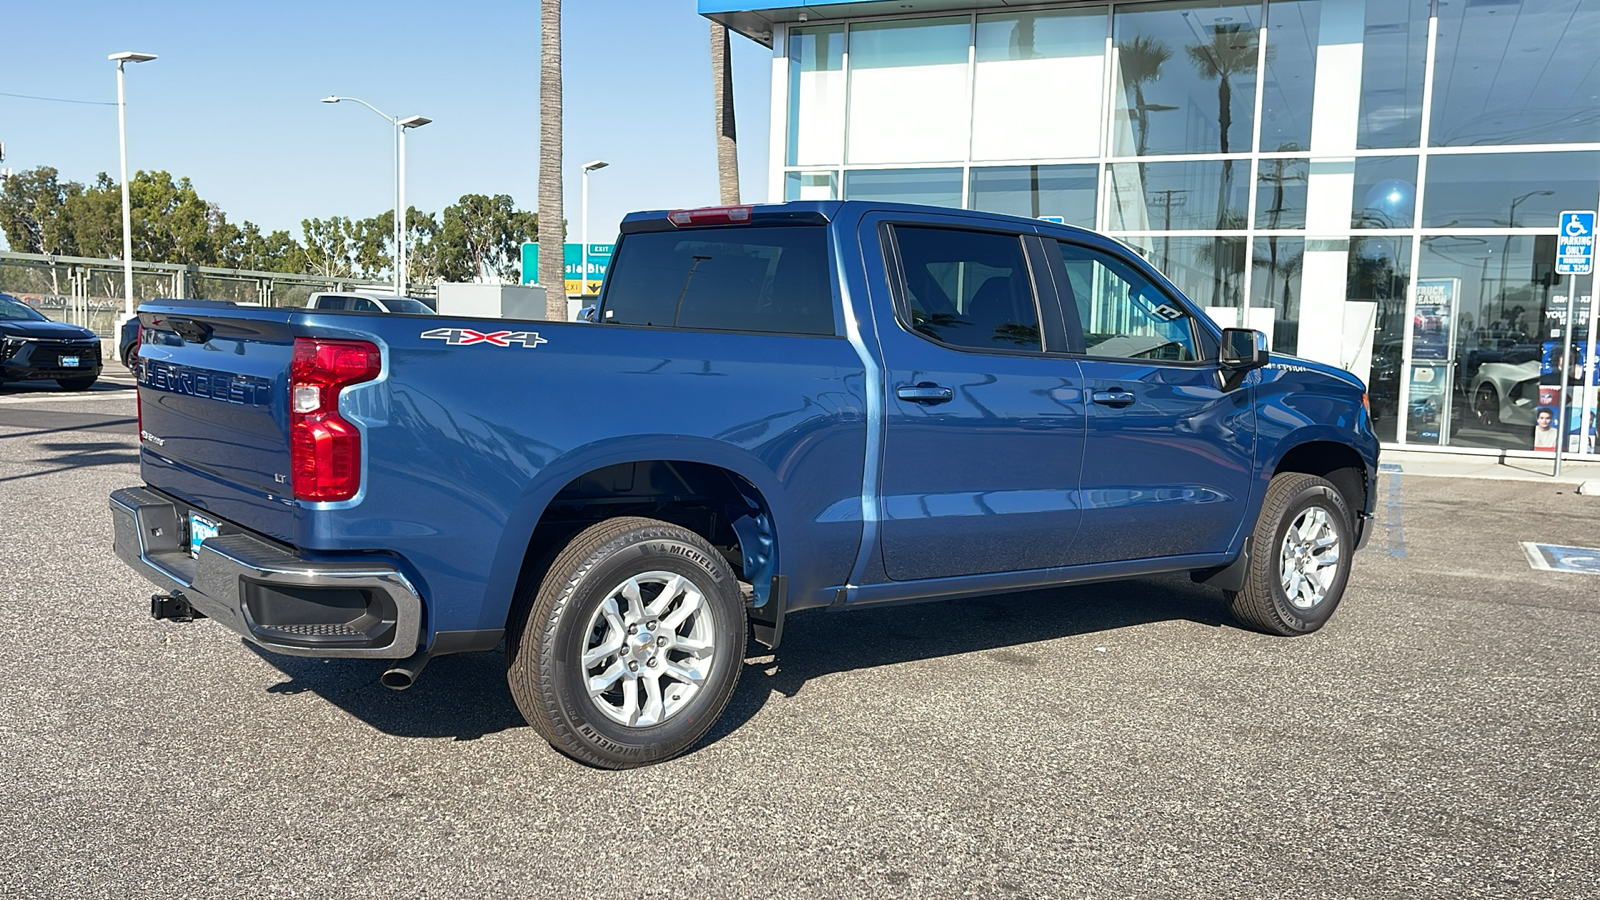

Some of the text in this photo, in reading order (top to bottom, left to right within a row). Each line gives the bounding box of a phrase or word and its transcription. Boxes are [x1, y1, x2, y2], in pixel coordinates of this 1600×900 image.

[1560, 235, 1592, 246] PARKING
[1565, 246, 1585, 255] ONLY
[587, 263, 607, 274] Blv
[1416, 286, 1445, 296] TRUCK
[1416, 295, 1447, 305] EASON
[274, 472, 286, 484] LT
[669, 544, 723, 580] MICHELIN
[581, 726, 641, 757] MICHELIN
